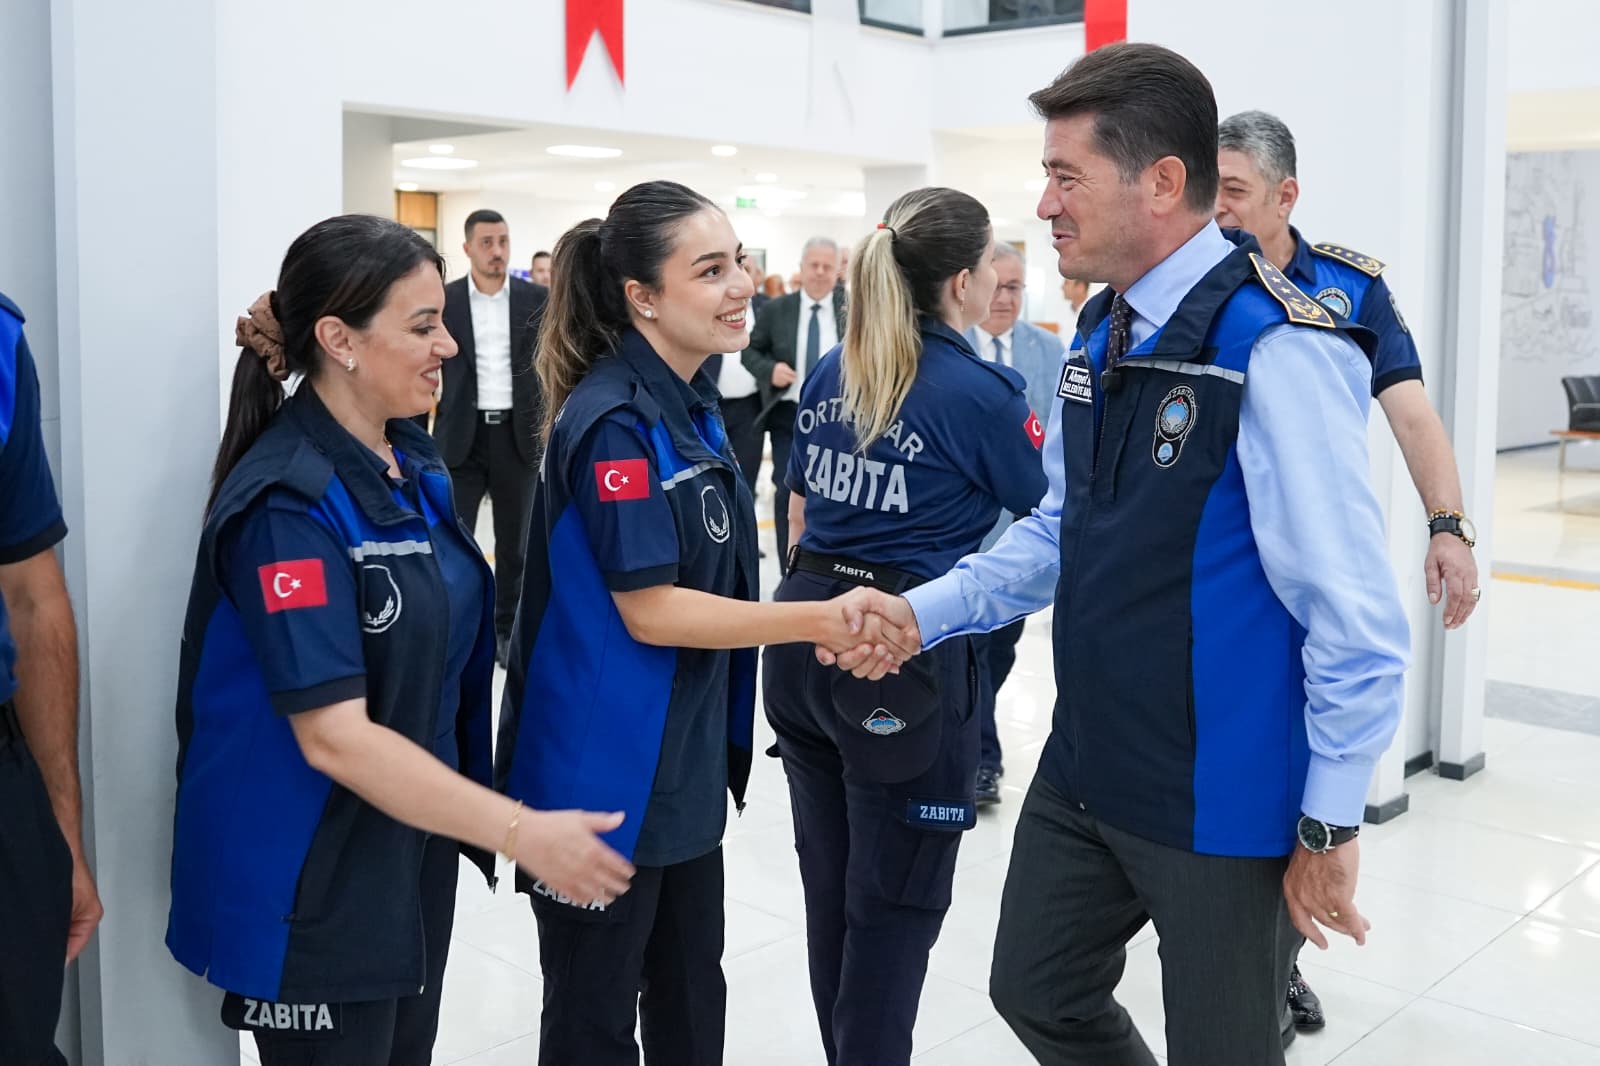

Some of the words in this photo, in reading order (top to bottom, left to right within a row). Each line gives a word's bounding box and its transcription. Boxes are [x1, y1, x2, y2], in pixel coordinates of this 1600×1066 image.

[805, 443, 909, 514] ZABITA
[833, 563, 875, 581] ZABITA
[919, 805, 965, 822] ZABITA
[243, 998, 334, 1031] ZABITA
